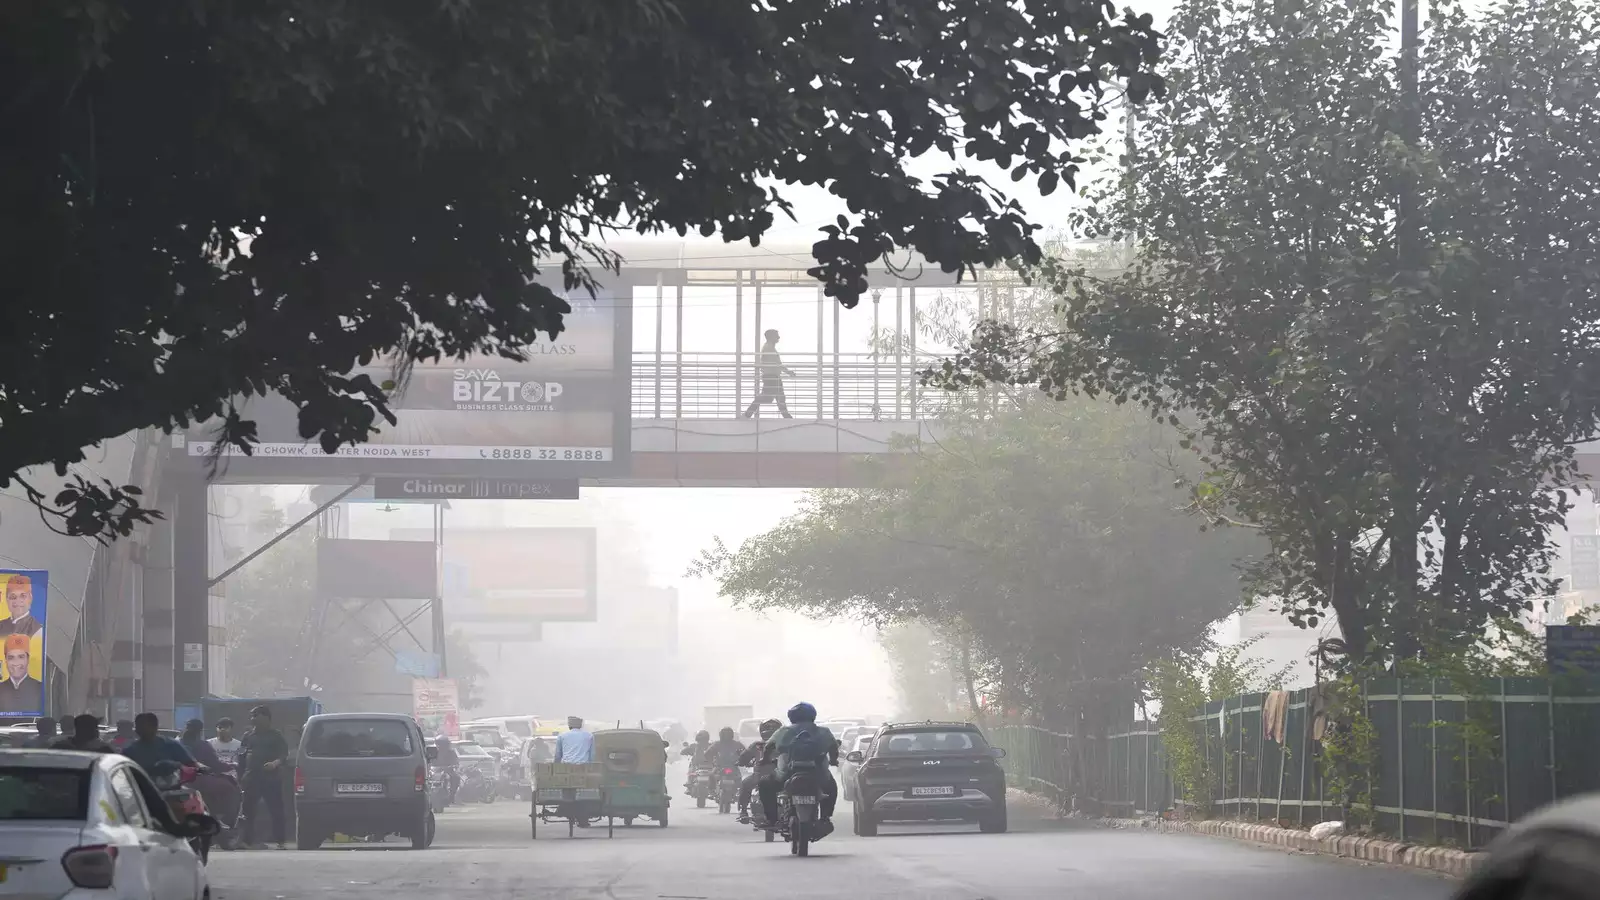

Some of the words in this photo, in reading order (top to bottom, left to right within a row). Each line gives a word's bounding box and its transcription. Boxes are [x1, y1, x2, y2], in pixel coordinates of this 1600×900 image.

[527, 342, 577, 355] CLASS
[453, 368, 501, 380] SAYA
[453, 380, 563, 403] BIZTOP
[456, 403, 497, 411] BUSINESS
[526, 404, 554, 412] SUITES
[228, 446, 260, 454] MUTI
[311, 447, 360, 455] GRATER
[363, 447, 397, 456] NOIDA
[401, 448, 431, 457] WEST
[492, 448, 532, 459] 8888
[539, 449, 557, 460] 32
[564, 449, 604, 460] 8888
[403, 480, 466, 494] Chinar
[495, 480, 553, 497] Impex
